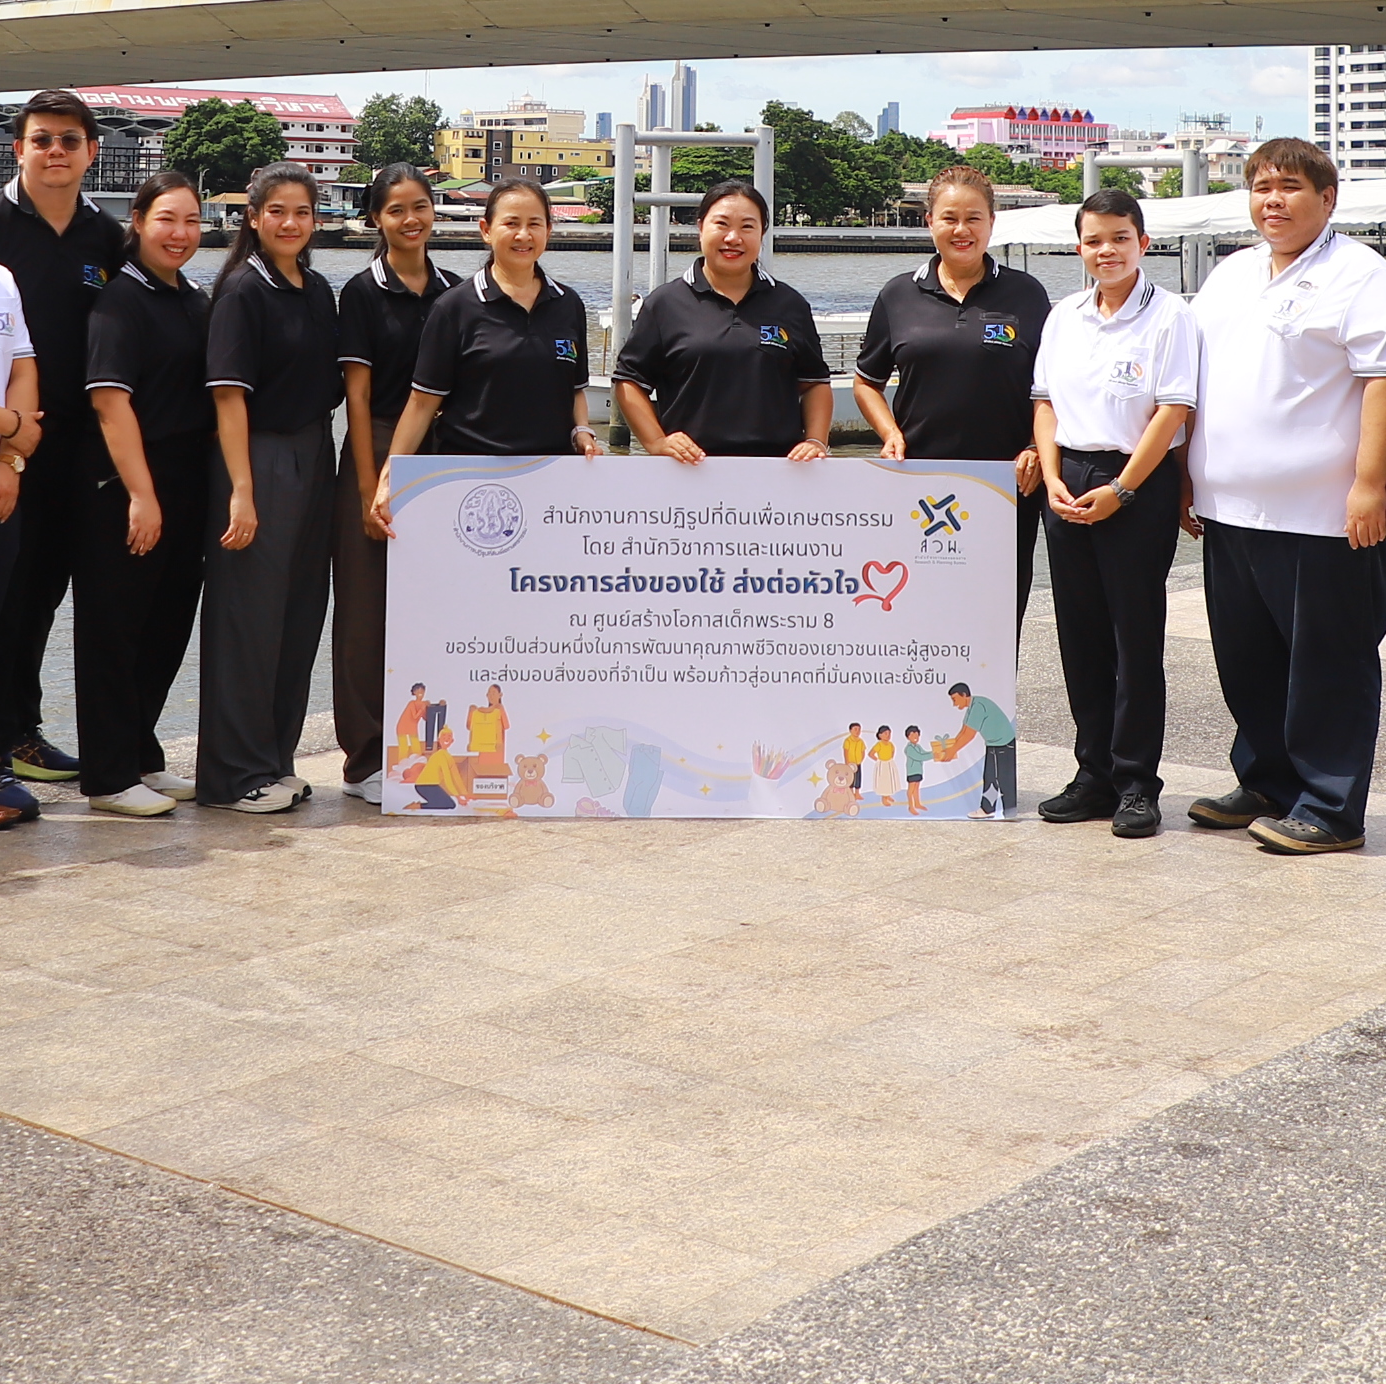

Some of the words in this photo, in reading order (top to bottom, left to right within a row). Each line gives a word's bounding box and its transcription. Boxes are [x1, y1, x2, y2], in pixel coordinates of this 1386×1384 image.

[760, 325, 779, 341] 51
[983, 324, 1006, 339] 51
[555, 339, 572, 356] 51
[1110, 361, 1132, 378] 51
[543, 501, 894, 530] สำนักงานการปฏิรูปที่ดินเพื่อเกษตรกรรม
[582, 535, 615, 556] โดย
[621, 536, 843, 558] สำนักวิชาการและแผนงาน
[509, 567, 725, 593] โครงการส่งของใช้
[732, 568, 860, 595] ส่งต่อหัวใจ
[569, 613, 587, 627] ณ
[593, 609, 817, 632] ศูนย์สร้างโอกาสเด็กพระราม
[823, 612, 835, 629] 8
[445, 633, 971, 662] ขอร่วมเป็นส่วนหนึ่งในการพัฒนาคุณภาพชีวิตของเยาวชนและผู้สูงอายุ
[469, 661, 667, 683] และส่งมอบสิ่งของที่จำเป็น
[673, 663, 947, 688] พร้อมก้าวสู่อนาคตที่มั่นคงและยั่งยืน
